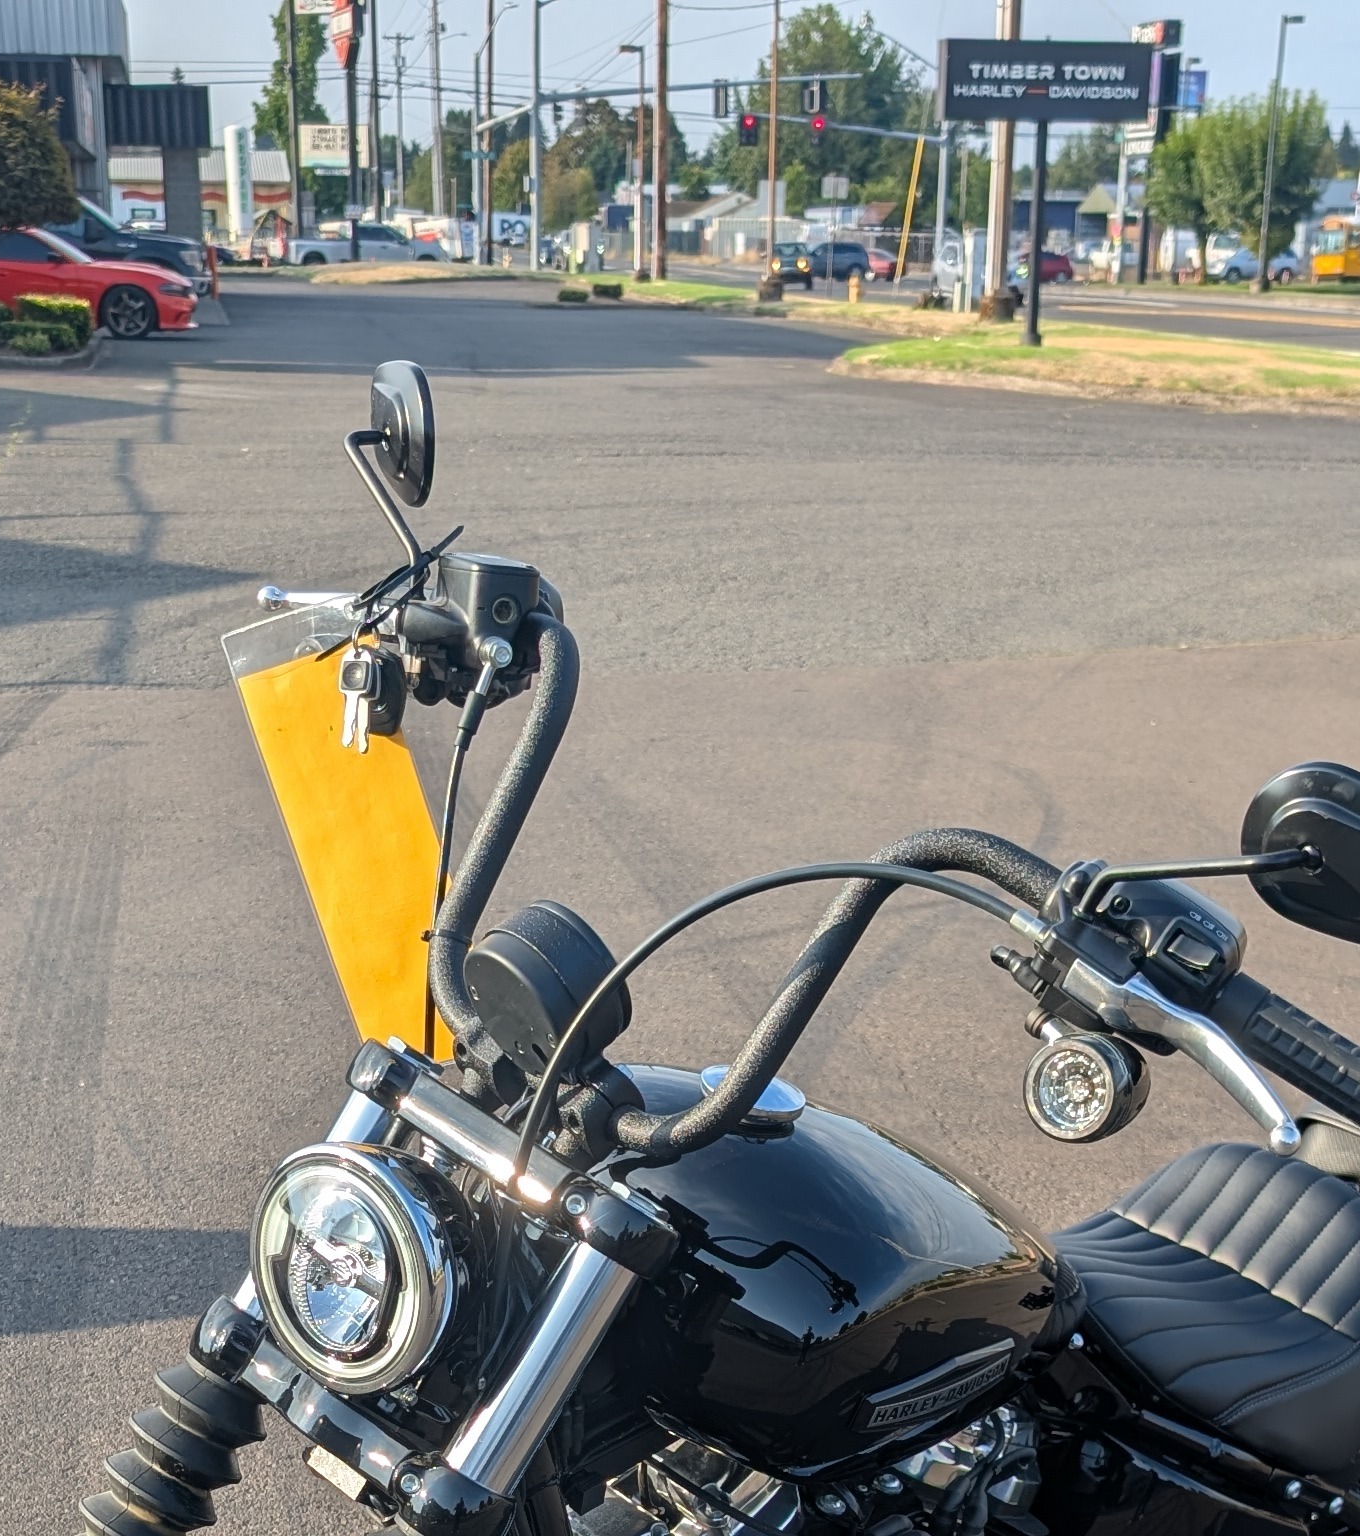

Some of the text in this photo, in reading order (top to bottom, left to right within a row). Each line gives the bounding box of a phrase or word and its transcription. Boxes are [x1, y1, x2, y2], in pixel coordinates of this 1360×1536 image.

[969, 62, 1126, 81] TIMBER TOWN
[872, 1359, 1008, 1424] HARLEY-DAVIDSON
